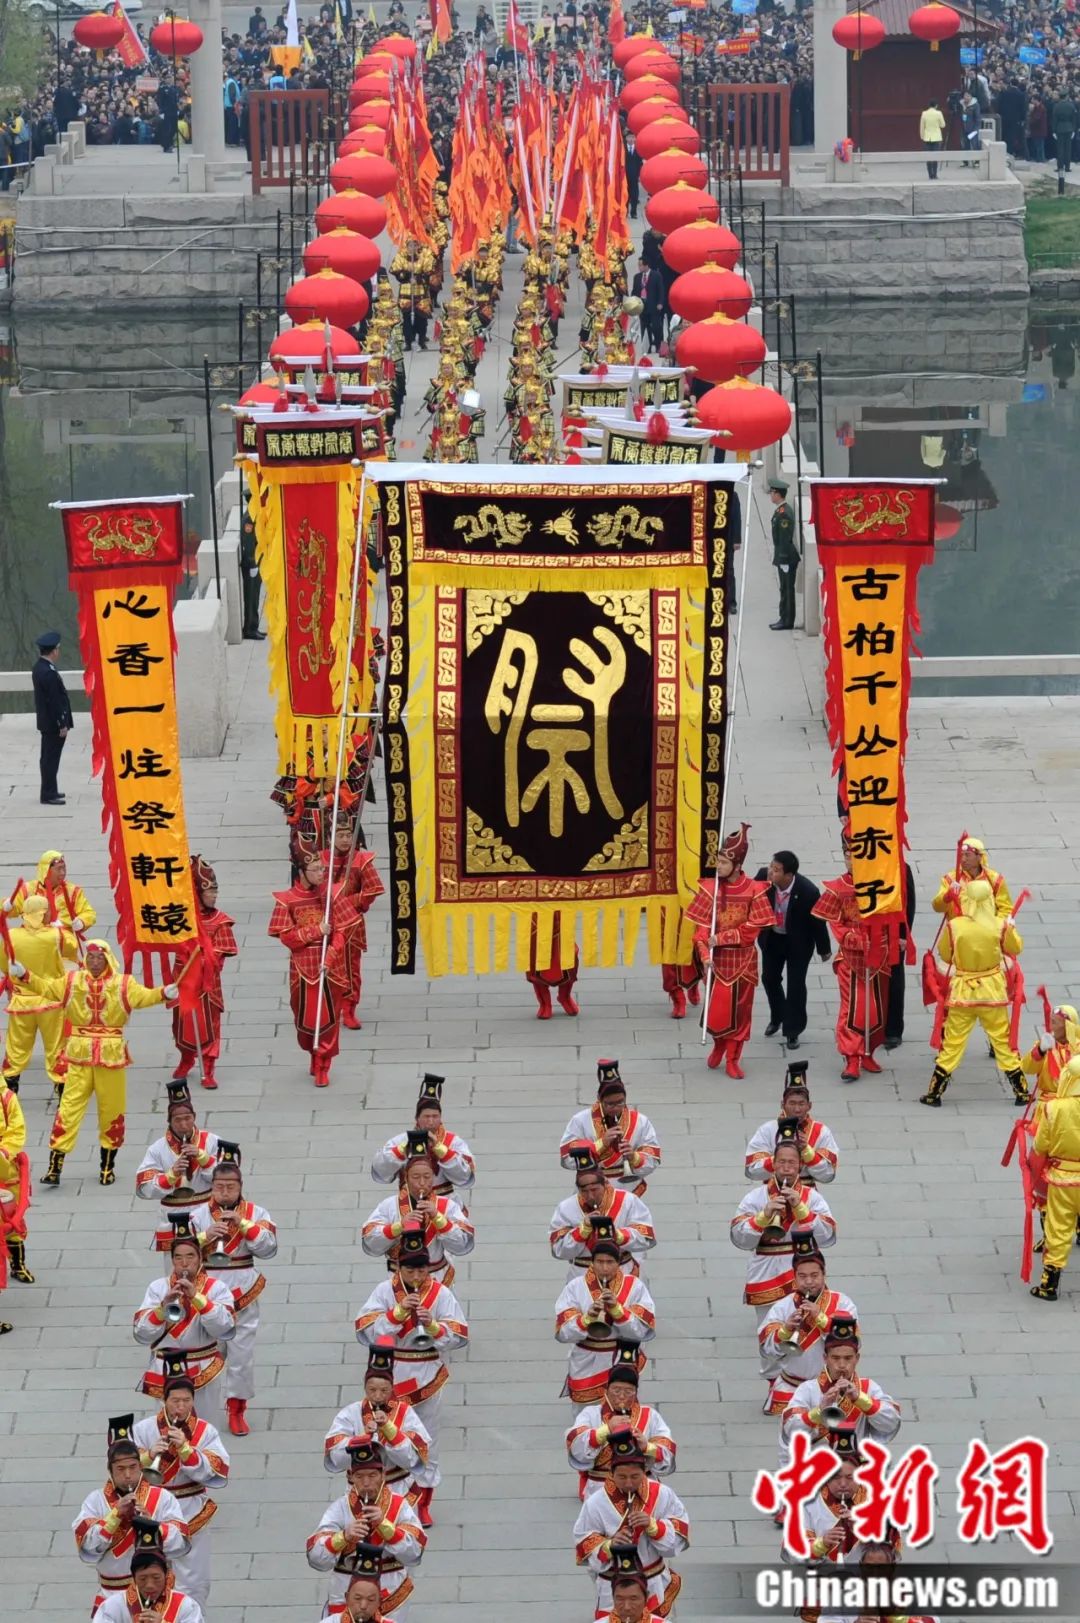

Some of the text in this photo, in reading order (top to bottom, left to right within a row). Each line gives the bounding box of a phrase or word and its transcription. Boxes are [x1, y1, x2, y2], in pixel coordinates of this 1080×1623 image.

[102, 590, 192, 936] 心香一炷祭軒轅
[841, 567, 900, 914] 古柏千丛迎赤子
